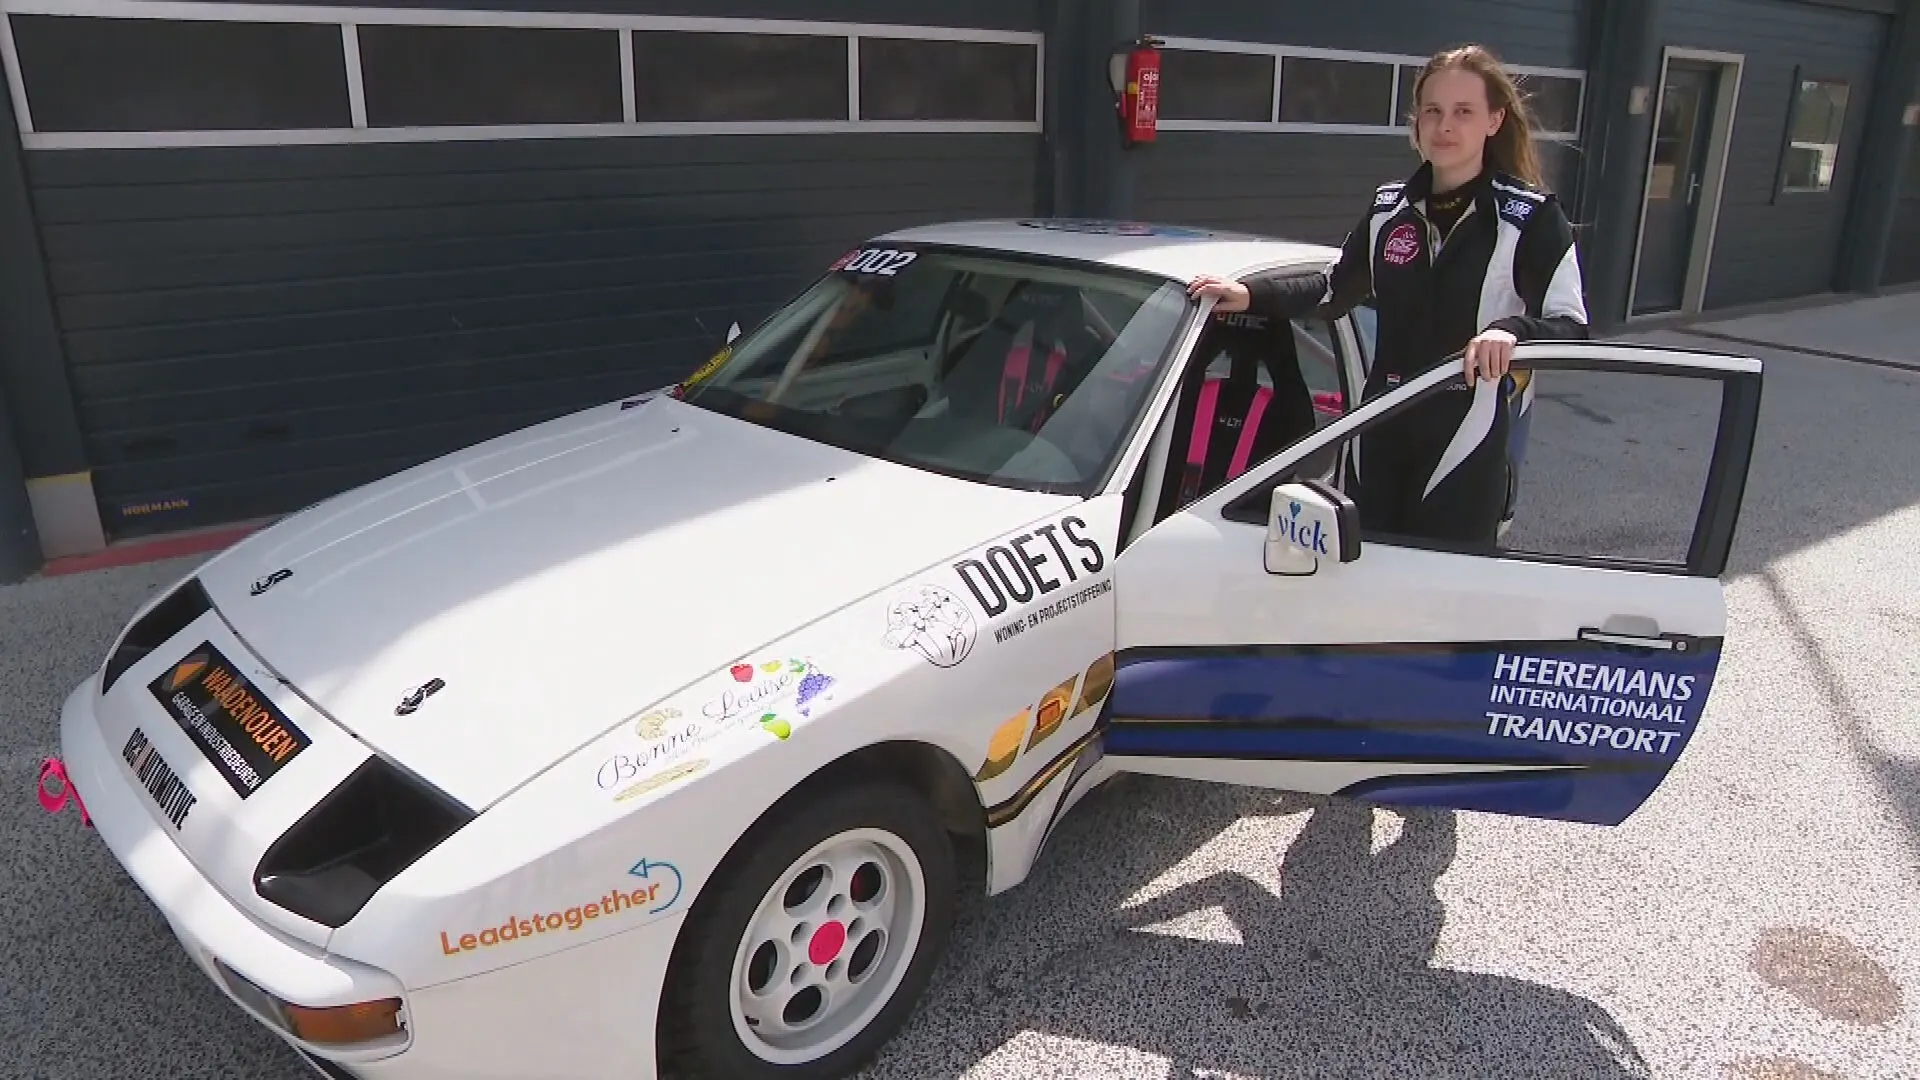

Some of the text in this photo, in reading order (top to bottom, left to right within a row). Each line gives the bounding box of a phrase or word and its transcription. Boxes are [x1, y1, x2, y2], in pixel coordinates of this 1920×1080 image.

[844, 247, 918, 276] 002
[953, 515, 1105, 619] DOETS
[994, 578, 1113, 645] WONING- EN PROJECTSTOFFERING
[1489, 684, 1686, 724] INTERNATIONAAL
[1493, 653, 1696, 701] HEEREMANS
[597, 723, 701, 791] Bonne
[702, 673, 794, 722] Louise
[1485, 711, 1682, 754] TRANSPORT
[137, 747, 198, 831] AUTOMOTIVE
[440, 882, 660, 956] Leadstogether
